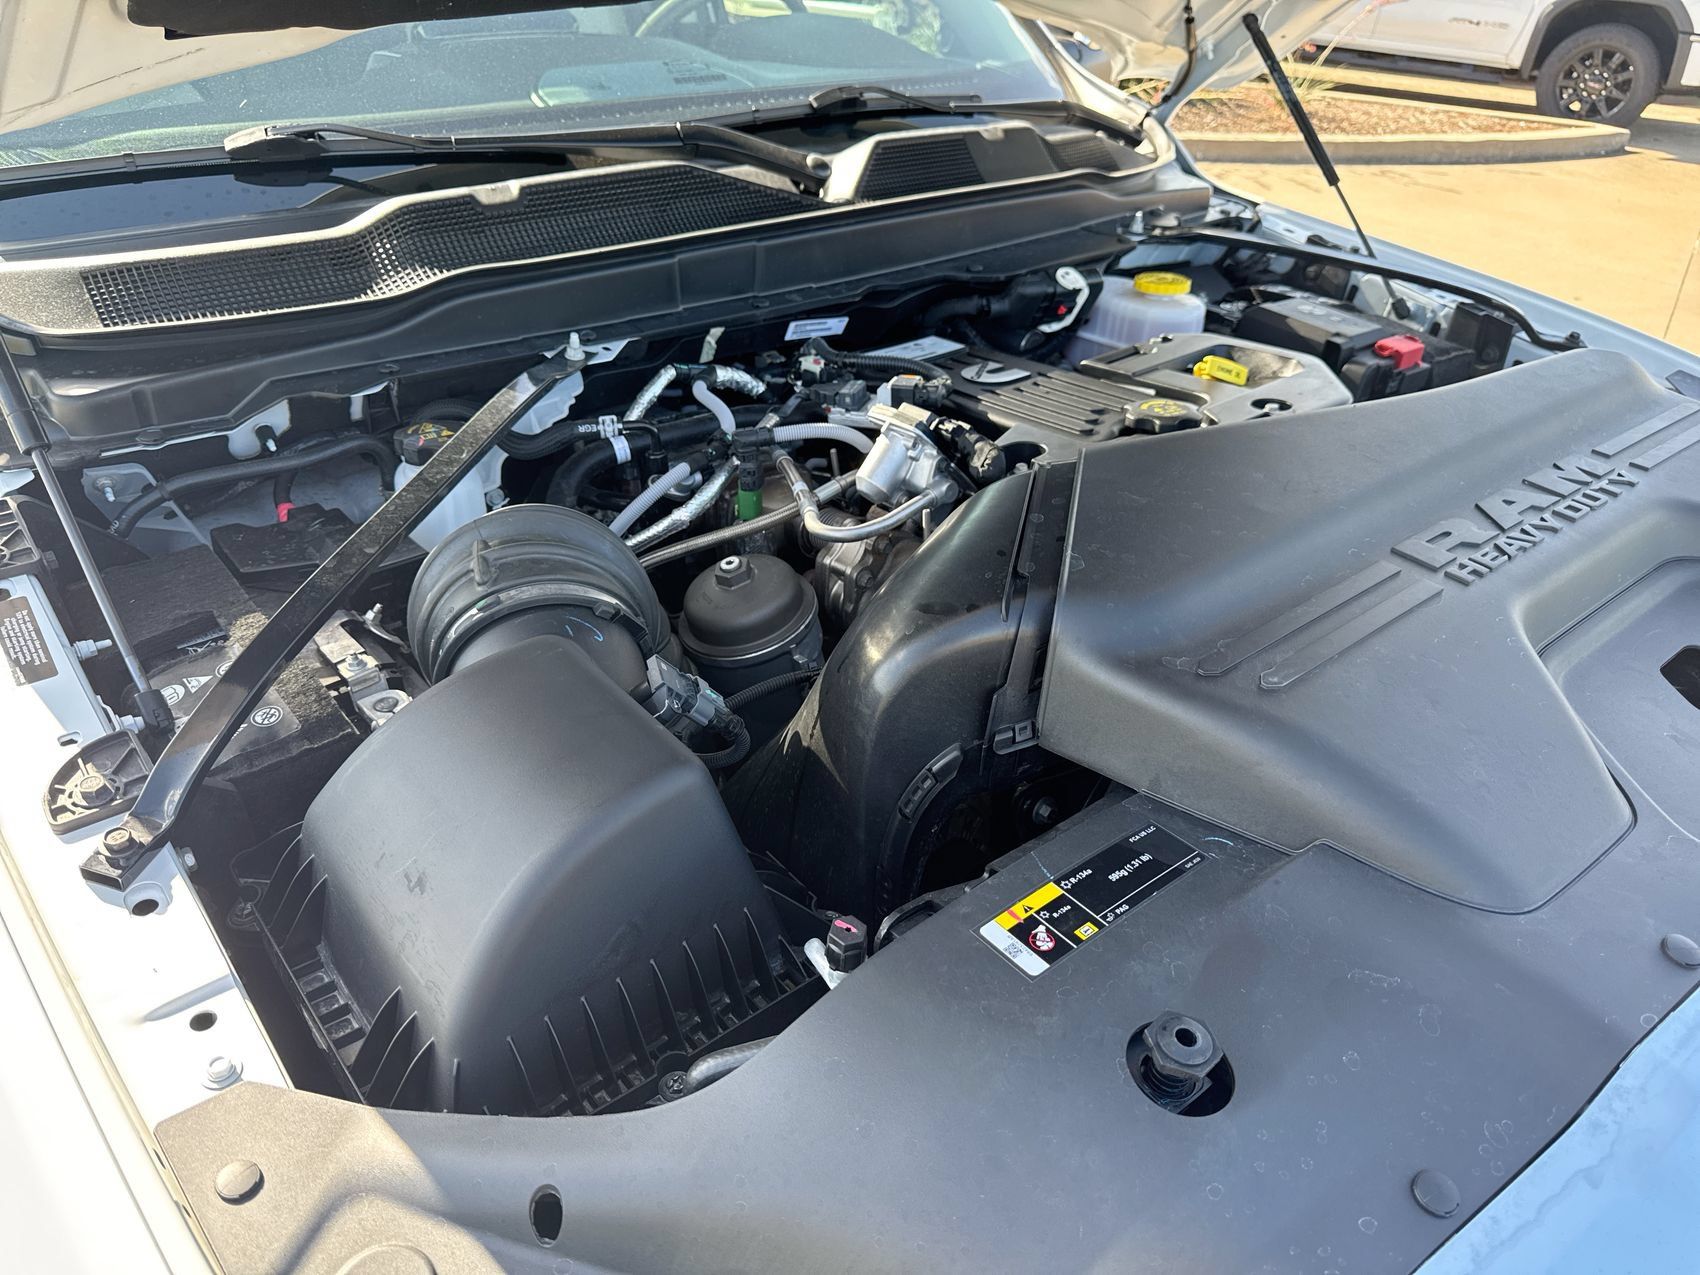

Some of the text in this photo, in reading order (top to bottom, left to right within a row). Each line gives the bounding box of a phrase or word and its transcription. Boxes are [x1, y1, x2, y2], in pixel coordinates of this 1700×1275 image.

[578, 424, 597, 432] EGR
[1391, 455, 1617, 573] RAM
[1444, 470, 1640, 586] HEAVY DUTY
[1128, 834, 1140, 843] FCA
[1145, 826, 1156, 834] LLC
[1108, 853, 1153, 882] 595g (1.31 lb)
[1070, 868, 1092, 884] R-134a
[1052, 904, 1072, 918] R-134a
[1115, 904, 1130, 915] PAG
